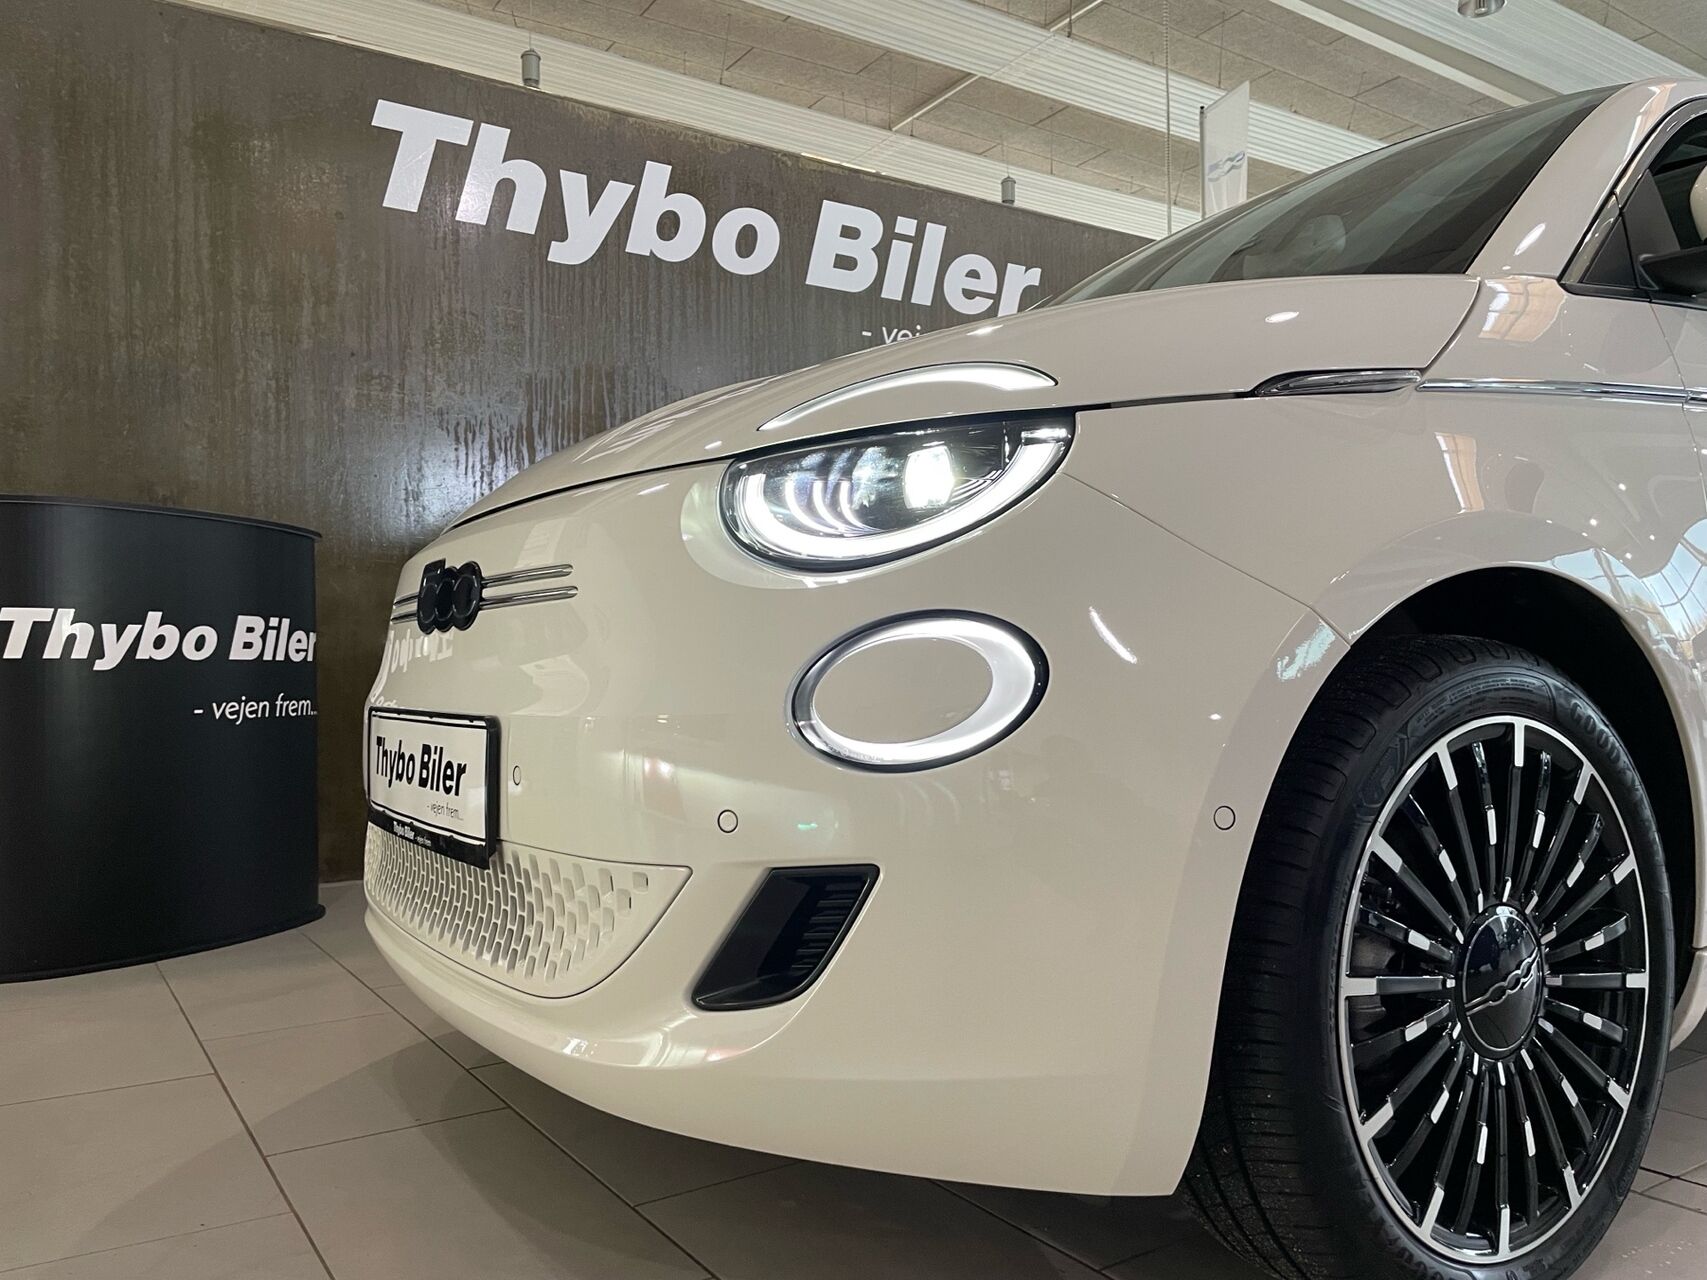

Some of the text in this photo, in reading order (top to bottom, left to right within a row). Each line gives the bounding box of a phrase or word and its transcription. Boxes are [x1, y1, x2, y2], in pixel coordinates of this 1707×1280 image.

[371, 99, 1042, 318] Thybo Biler
[0, 607, 317, 671] Thybo Biler
[212, 695, 270, 725] vejen
[376, 736, 467, 796] Thybo Biler
